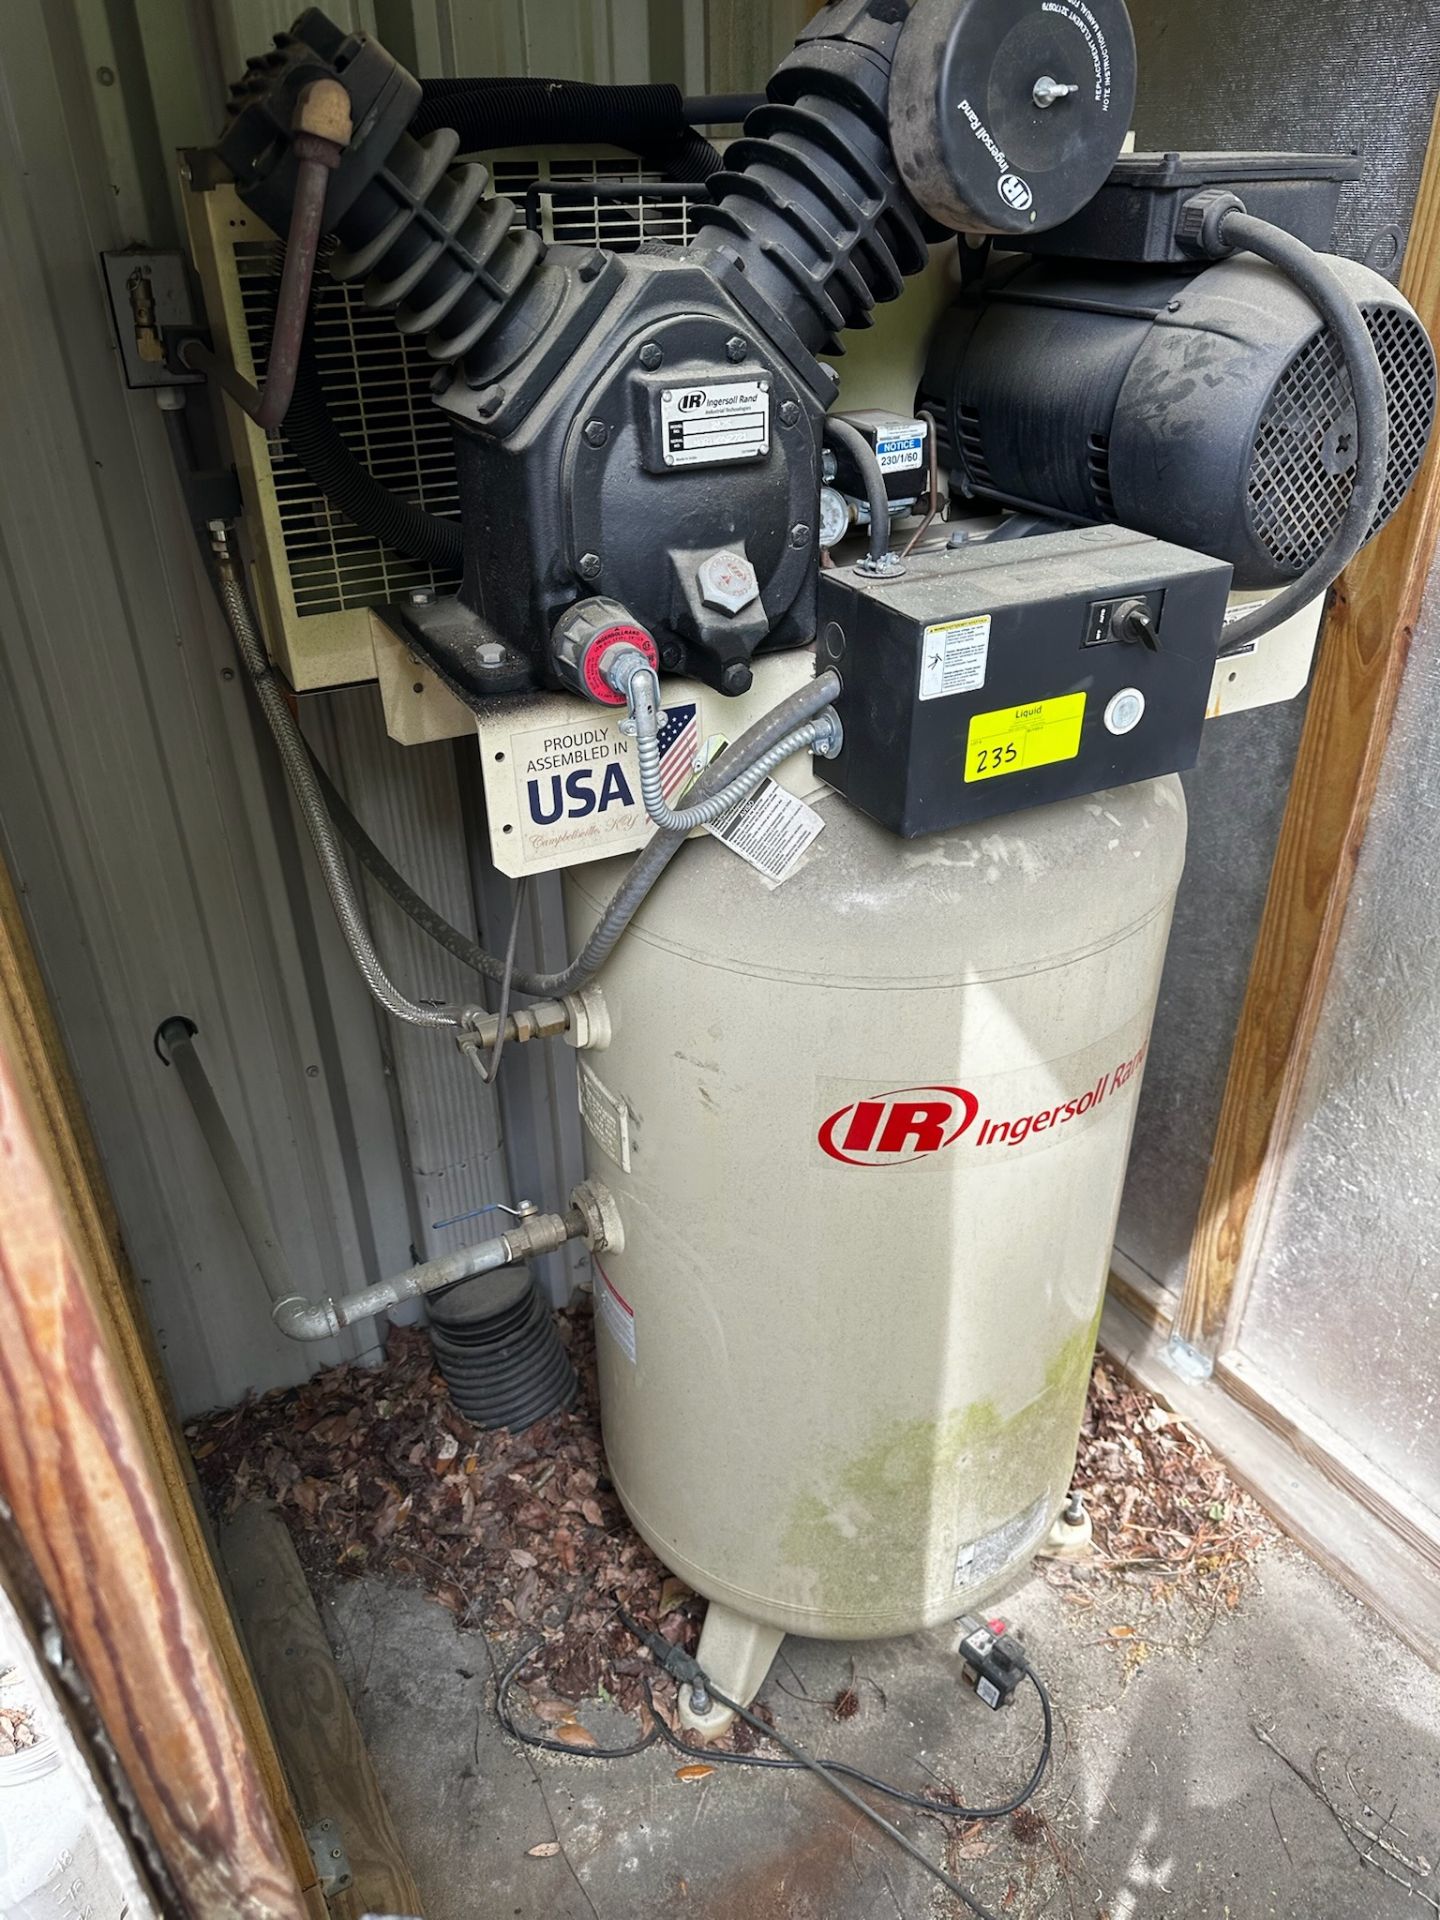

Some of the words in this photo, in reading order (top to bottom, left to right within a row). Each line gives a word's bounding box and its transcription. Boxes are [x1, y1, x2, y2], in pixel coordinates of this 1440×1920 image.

[1068, 11, 1092, 41] ELEMENT
[1080, 2, 1100, 32] MANUAL
[1088, 40, 1102, 101] REPLACEMENT
[1096, 30, 1111, 86] INSTRUCTION
[1102, 87, 1111, 112] NOTE
[957, 99, 981, 131] Rand
[975, 127, 1010, 174] Ingersoll
[1001, 175, 1031, 209] IR
[681, 393, 703, 410] IR
[706, 395, 738, 408] Ingersoll
[740, 394, 758, 403] Rand
[881, 451, 918, 466] 230/1/60
[884, 439, 916, 452] NOTICE
[1015, 705, 1042, 719] Liquid
[544, 728, 608, 752] PROUDLY
[527, 745, 609, 773] ASSEMBLED
[614, 741, 628, 755] IN
[976, 742, 1017, 773] 235
[527, 762, 635, 825] USA
[605, 814, 640, 832] KY
[740, 800, 756, 818] AVISO
[842, 1101, 953, 1152] IR
[976, 1073, 1110, 1146] Ingersoll
